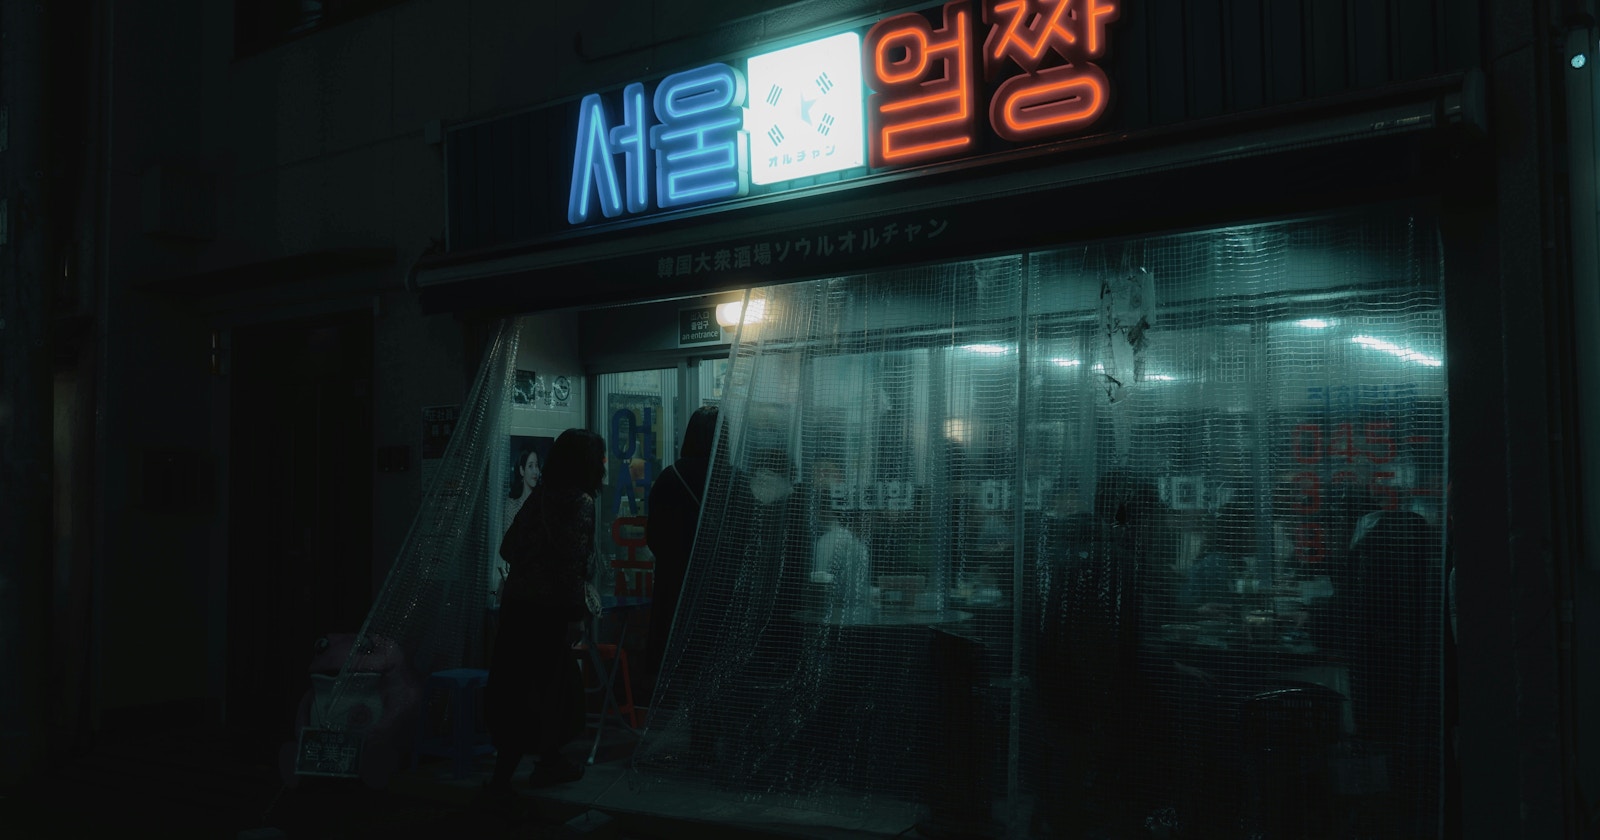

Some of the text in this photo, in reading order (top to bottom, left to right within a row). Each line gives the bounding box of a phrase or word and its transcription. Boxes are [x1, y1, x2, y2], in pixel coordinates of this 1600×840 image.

[567, 0, 1120, 224] 서울 얼짱
[768, 144, 836, 168] オルチャン
[656, 218, 949, 279] 韓国大衆酒場ソウルオルチャン
